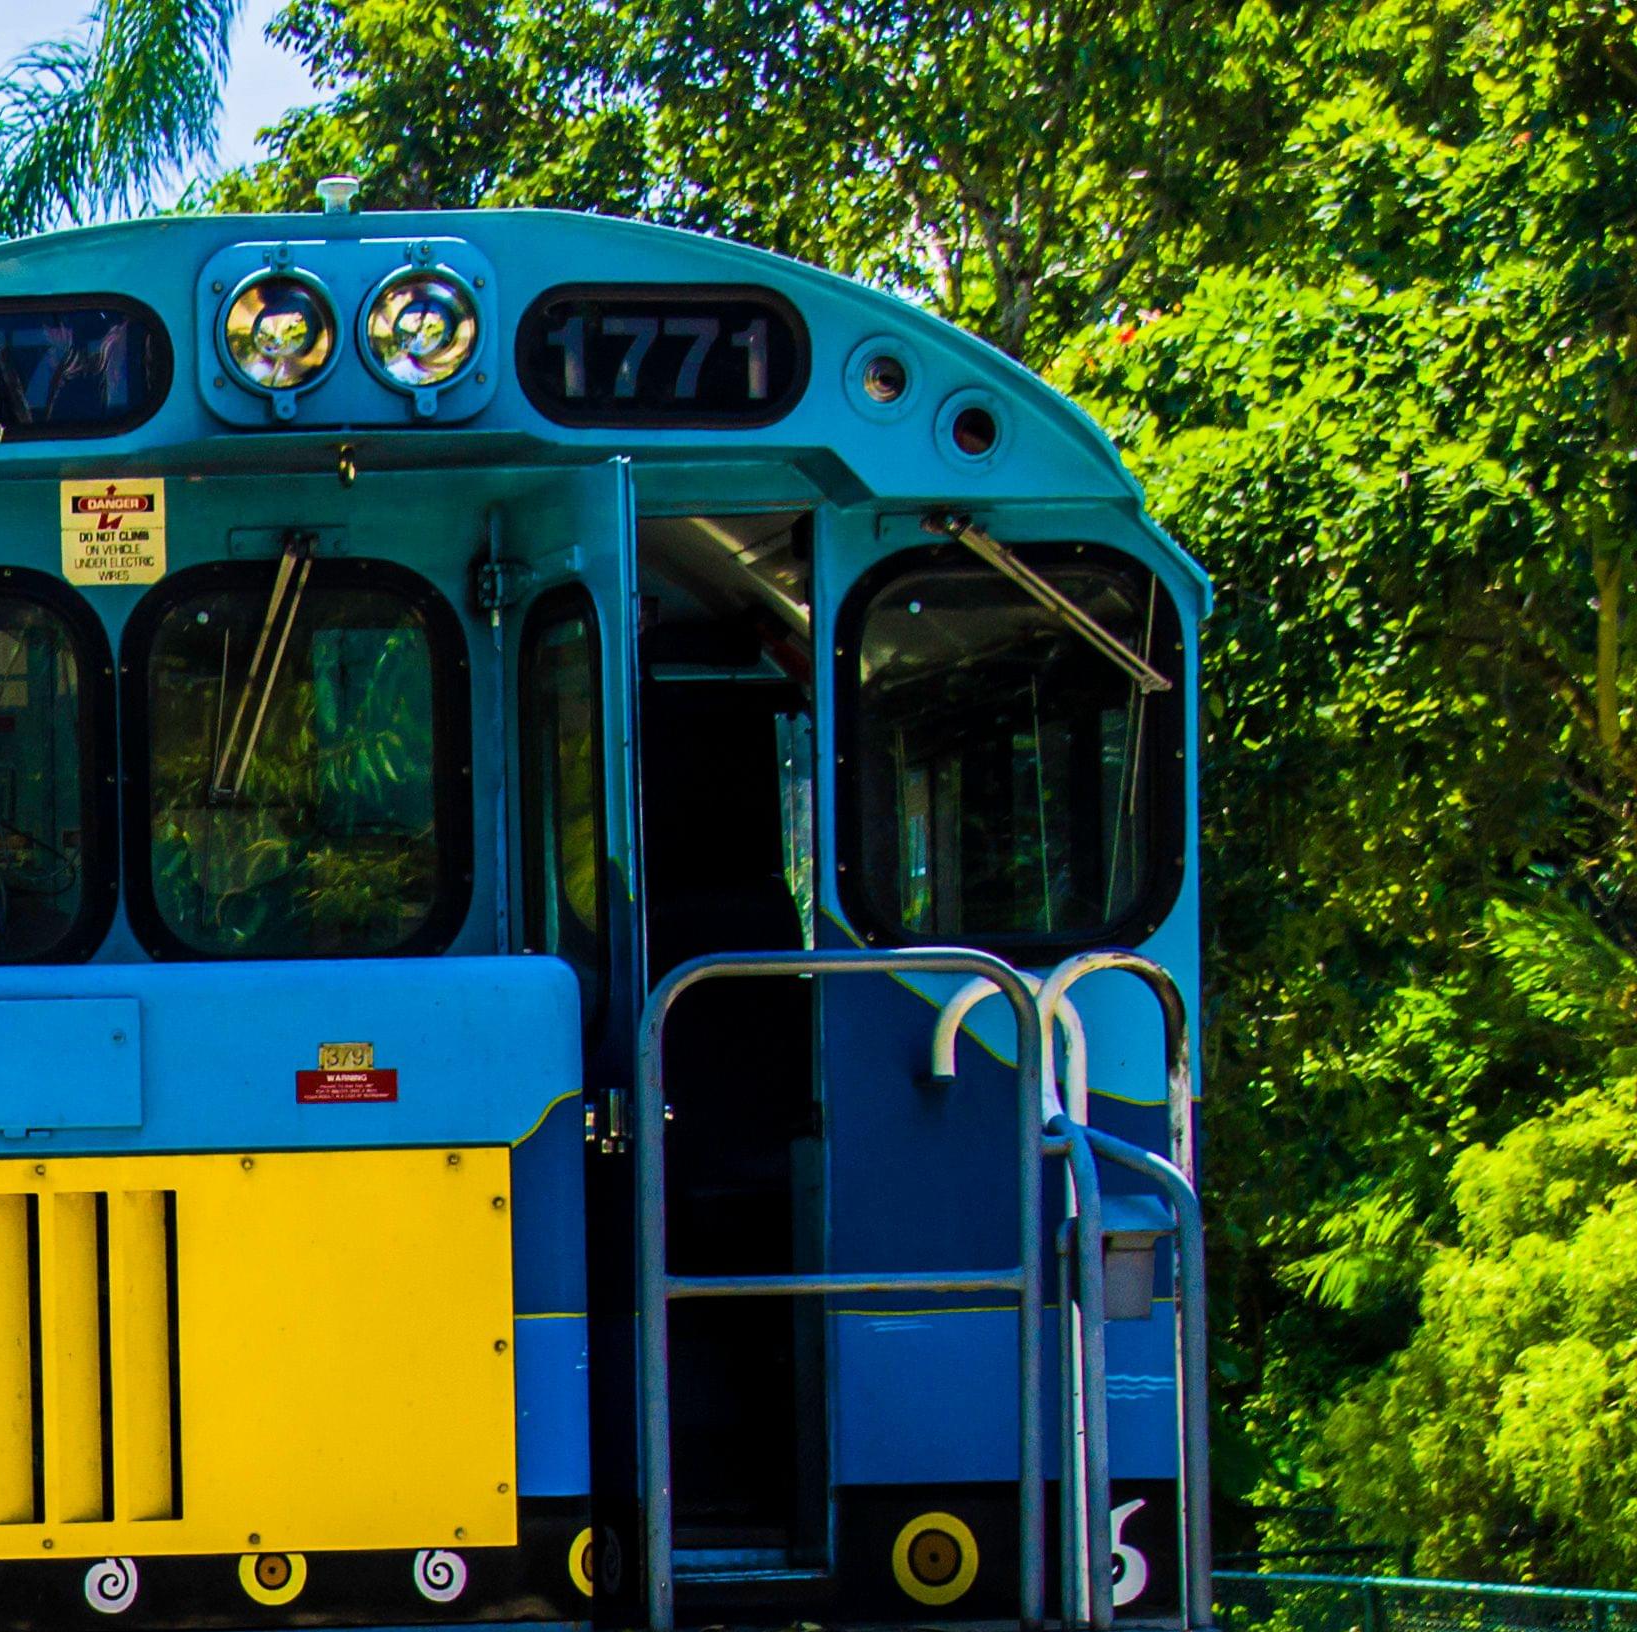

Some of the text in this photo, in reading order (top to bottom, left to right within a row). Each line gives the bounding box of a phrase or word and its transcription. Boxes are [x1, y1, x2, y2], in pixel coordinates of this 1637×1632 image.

[548, 317, 768, 398] 1771
[87, 498, 139, 510] DANGER
[79, 530, 149, 542] DO NOT CLIMB
[85, 544, 141, 555] ON VEHICLE
[75, 556, 155, 569] UNDER ELECTRIC
[99, 570, 129, 581] WIRES
[327, 1073, 367, 1082] WARNING
